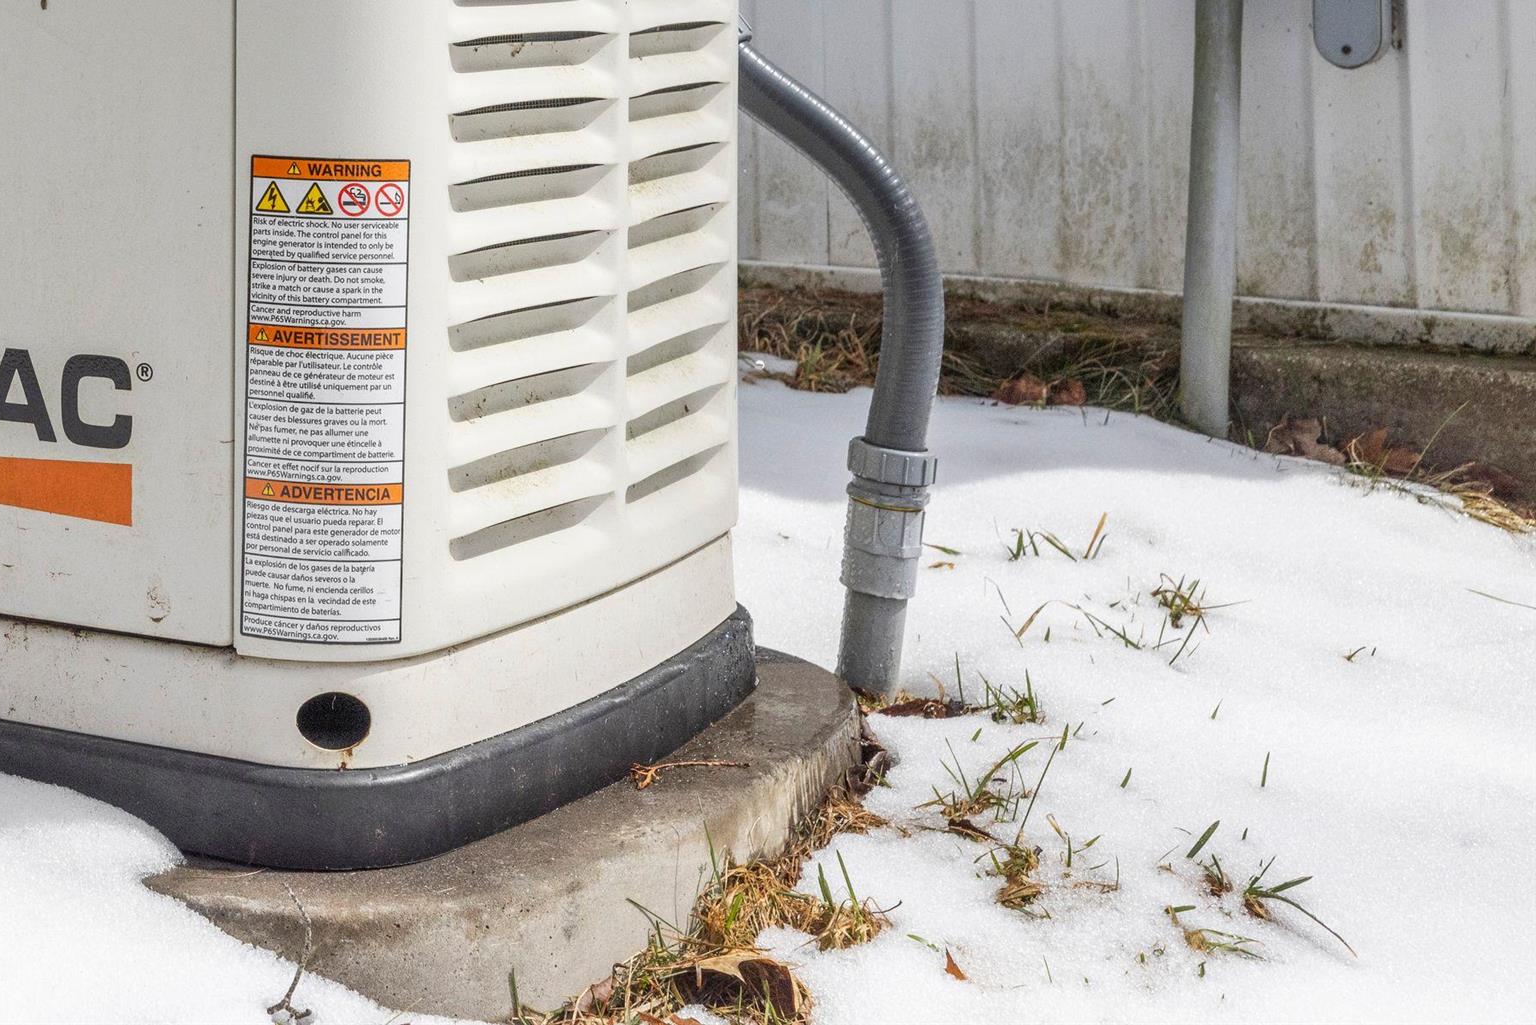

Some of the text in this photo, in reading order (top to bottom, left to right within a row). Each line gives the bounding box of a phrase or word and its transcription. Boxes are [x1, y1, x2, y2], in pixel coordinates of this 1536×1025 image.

[308, 163, 382, 177] WARNING
[253, 217, 267, 225] Risk
[278, 219, 304, 227] electric
[306, 220, 330, 228] shock.
[253, 227, 271, 238] parts
[272, 228, 296, 237] inside.
[297, 230, 311, 238] The
[312, 230, 339, 239] control
[341, 231, 362, 241] panel
[253, 237, 384, 251] engine generator intended only
[252, 248, 285, 259] operated
[297, 250, 330, 261] qualified
[252, 261, 286, 273] Explosion
[297, 264, 324, 274] battery
[276, 273, 297, 284] injury
[308, 275, 332, 283] death.
[252, 281, 271, 290] strike
[278, 283, 301, 292] match
[342, 286, 362, 296] spark
[251, 292, 276, 302] vicinity
[287, 294, 301, 302] this
[302, 295, 329, 305] battery
[251, 305, 275, 314] Cancer
[276, 307, 290, 315] and
[292, 308, 340, 319] reproductive
[251, 315, 346, 326] www.P65Warnings.ca.gov.
[273, 330, 401, 346] AVERTISSEMENT
[286, 350, 304, 358] choc
[305, 351, 345, 362] électrique.
[376, 352, 394, 362] pièce
[250, 357, 284, 369] réparable
[285, 362, 297, 370] par
[250, 369, 280, 379] panneau
[304, 371, 345, 382] générateur
[249, 377, 275, 386] destiné
[282, 380, 298, 388] être
[299, 381, 321, 389] utilisé
[323, 382, 368, 392] uniquement
[249, 387, 315, 401] personnel qualifié.
[300, 407, 314, 415] gaz
[335, 407, 364, 415] batterie
[365, 407, 382, 417] peut
[273, 414, 286, 422] des
[287, 415, 322, 424] blessures
[324, 419, 348, 427] graves
[260, 426, 272, 434] pas
[274, 425, 298, 435] fumer,
[310, 430, 323, 438] pas
[324, 428, 353, 437] allumer
[291, 439, 330, 449] provoquer
[248, 445, 281, 457] proximité
[303, 449, 356, 460] compartiment
[247, 458, 272, 468] Cancer
[282, 462, 299, 470] effet
[300, 463, 319, 472] nocif
[342, 465, 389, 475] reproduction
[247, 469, 343, 482] www.P65Warnings.ca.gov.
[280, 485, 390, 501] ADVERTENCIA
[247, 501, 378, 517] Riesgo descarga eléctrica. hay
[246, 512, 268, 523] piezas
[269, 516, 284, 524] que
[293, 516, 321, 524] usuario
[322, 517, 347, 527] pueda
[246, 521, 271, 531] control
[272, 524, 293, 535] panel
[294, 528, 311, 536] para
[313, 527, 328, 535] este
[330, 528, 368, 538] generador
[246, 531, 260, 540] está
[261, 533, 298, 544] destinado
[318, 538, 350, 548] operado
[246, 543, 258, 552] por
[259, 543, 290, 555] personal
[303, 547, 332, 556] servicio
[254, 558, 287, 571] explosión
[299, 563, 310, 571] los
[311, 565, 331, 574] gases
[245, 568, 267, 580] puede
[291, 573, 313, 582] daños
[285, 583, 306, 593] fume,
[315, 585, 348, 594] encienda
[252, 591, 269, 602] haga
[270, 592, 296, 604] chispas
[318, 596, 350, 605] vecindad
[244, 600, 342, 615] compartimiento baterías.
[244, 615, 381, 634] Produce cáncer daños reproductivos
[244, 626, 339, 641] www.P65Warnings.ca.gov.
